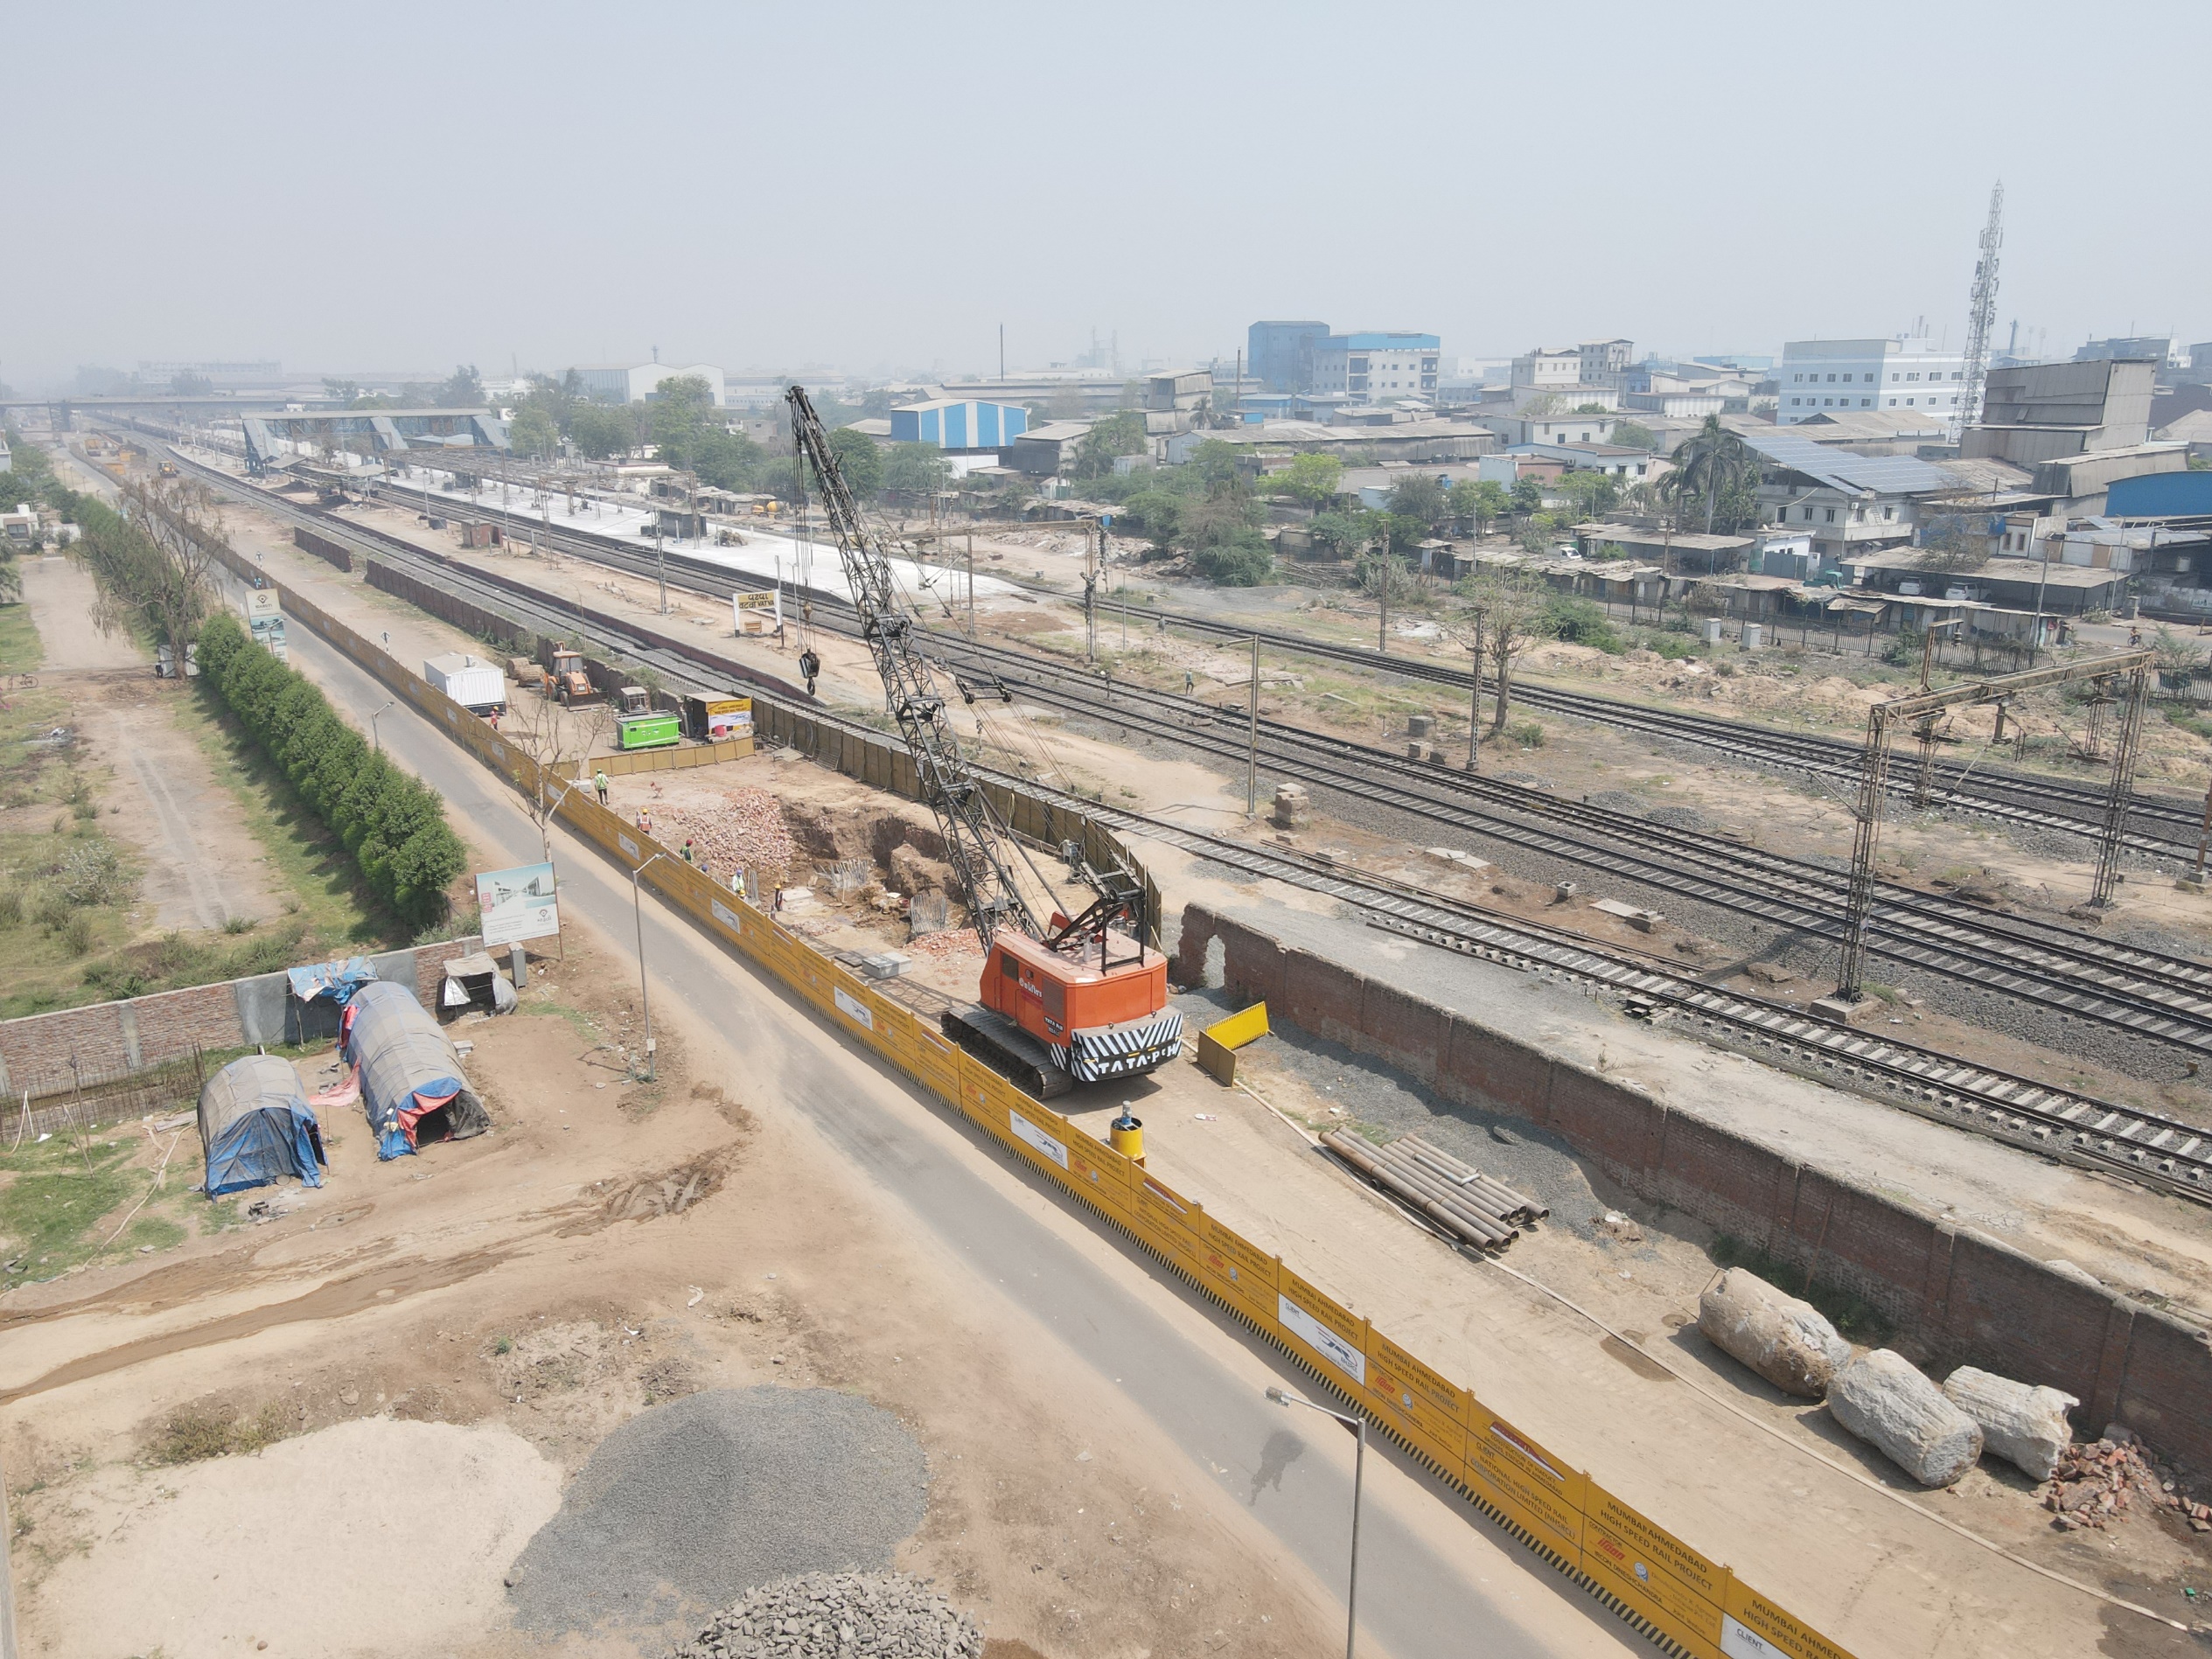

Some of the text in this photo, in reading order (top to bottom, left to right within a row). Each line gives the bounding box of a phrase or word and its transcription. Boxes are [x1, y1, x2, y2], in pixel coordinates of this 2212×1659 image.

[1209, 1232, 1271, 1278] HIGH SPEED RAIL PROJECT
[1211, 1224, 1267, 1265] MUMBAI AHMEDABAD
[1288, 1286, 1302, 1300] HIGH
[1303, 1296, 1320, 1314] SPEED
[1321, 1310, 1334, 1323] RAIL
[1335, 1319, 1358, 1341] PROJECT
[1293, 1279, 1316, 1300] MUMBAI
[1317, 1296, 1355, 1327] AHMEDABAD
[1378, 1350, 1393, 1367] HIGH
[1394, 1363, 1414, 1381] SPEED
[1415, 1378, 1430, 1392] RAIL
[1431, 1389, 1460, 1413] PROJECT
[1382, 1343, 1410, 1368] MUMBAI
[1412, 1364, 1455, 1398] AHMEDABAD
[1476, 1442, 1495, 1459] CLIENT
[1490, 1434, 1525, 1462] CONSTRUCTION
[1471, 1458, 1575, 1539] CORPORATION LIMITED (NHSRCL)
[1480, 1455, 1568, 1523] NATIONAL HIGH SPEED RAIL
[1589, 1522, 1622, 1547] CONTRACTOR
[1601, 1509, 1622, 1529] HIGH
[1623, 1525, 1650, 1548] SPEED
[1652, 1544, 1672, 1564] RAIL
[1674, 1560, 1713, 1591] PROJECT
[1608, 1502, 1647, 1533] MUMBAI
[1648, 1530, 1707, 1573] AHMEDABAD
[1594, 1551, 1612, 1566] IRCON
[1613, 1562, 1663, 1603] DINESHCHANDRA
[1737, 1628, 1763, 1650] CLIENT
[1744, 1609, 1769, 1630] HIGH
[1771, 1627, 1803, 1652] SPEED
[1752, 1600, 1797, 1635] MUMBAI
